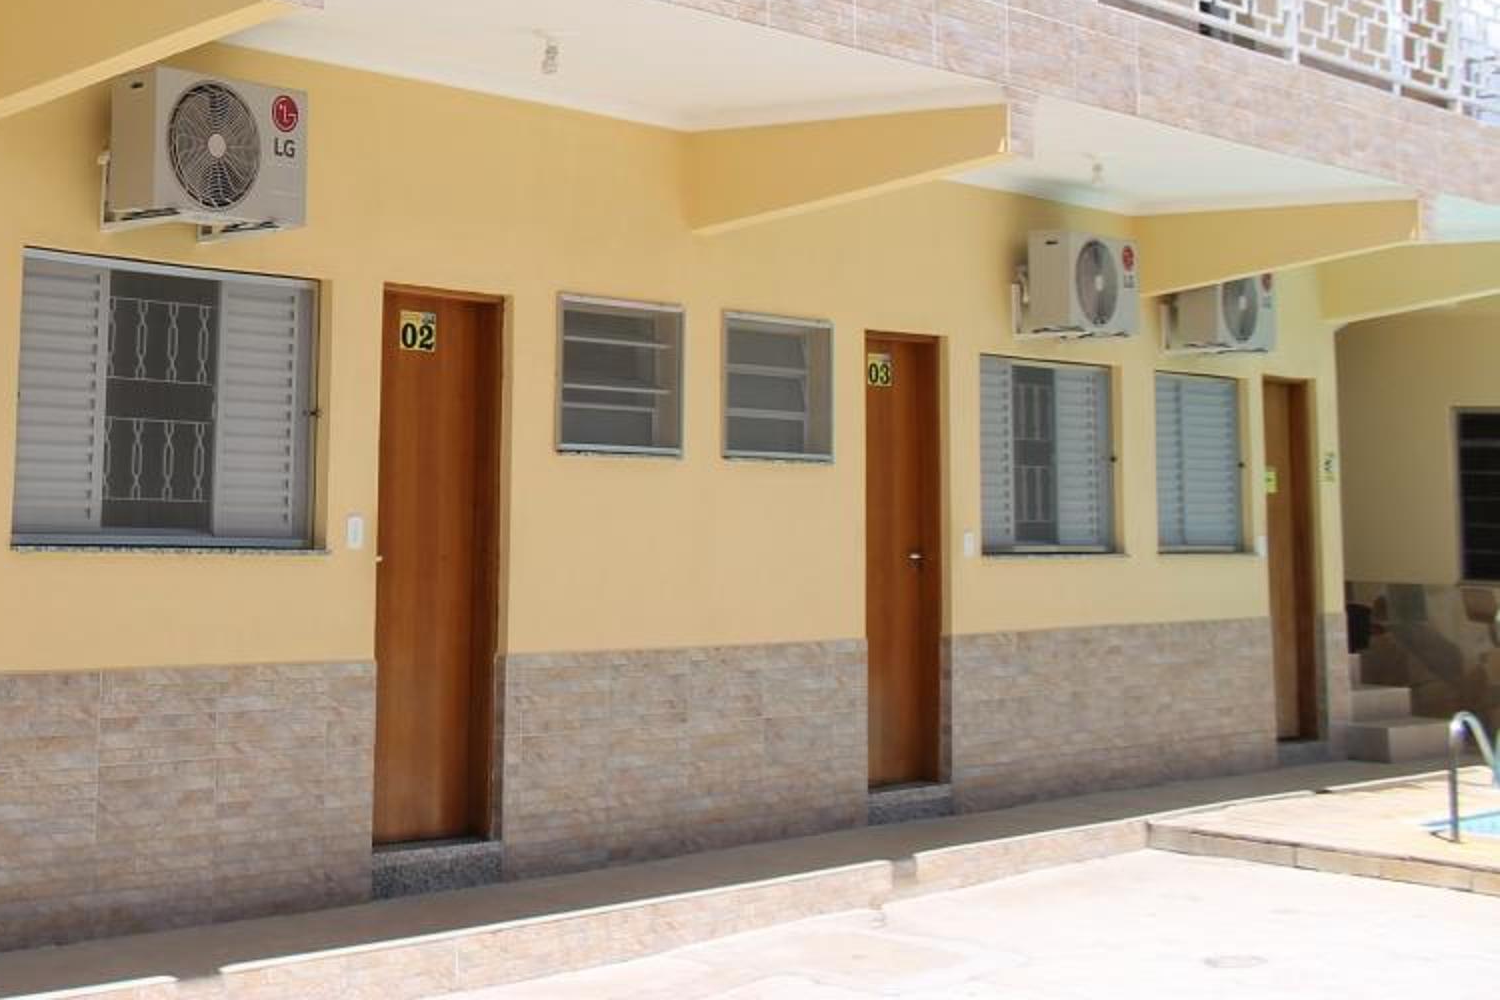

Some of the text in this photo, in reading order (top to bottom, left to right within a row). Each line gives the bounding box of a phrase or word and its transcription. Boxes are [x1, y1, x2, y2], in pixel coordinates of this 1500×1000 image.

[274, 136, 296, 158] LG
[402, 322, 434, 350] 02
[869, 362, 890, 385] 03
